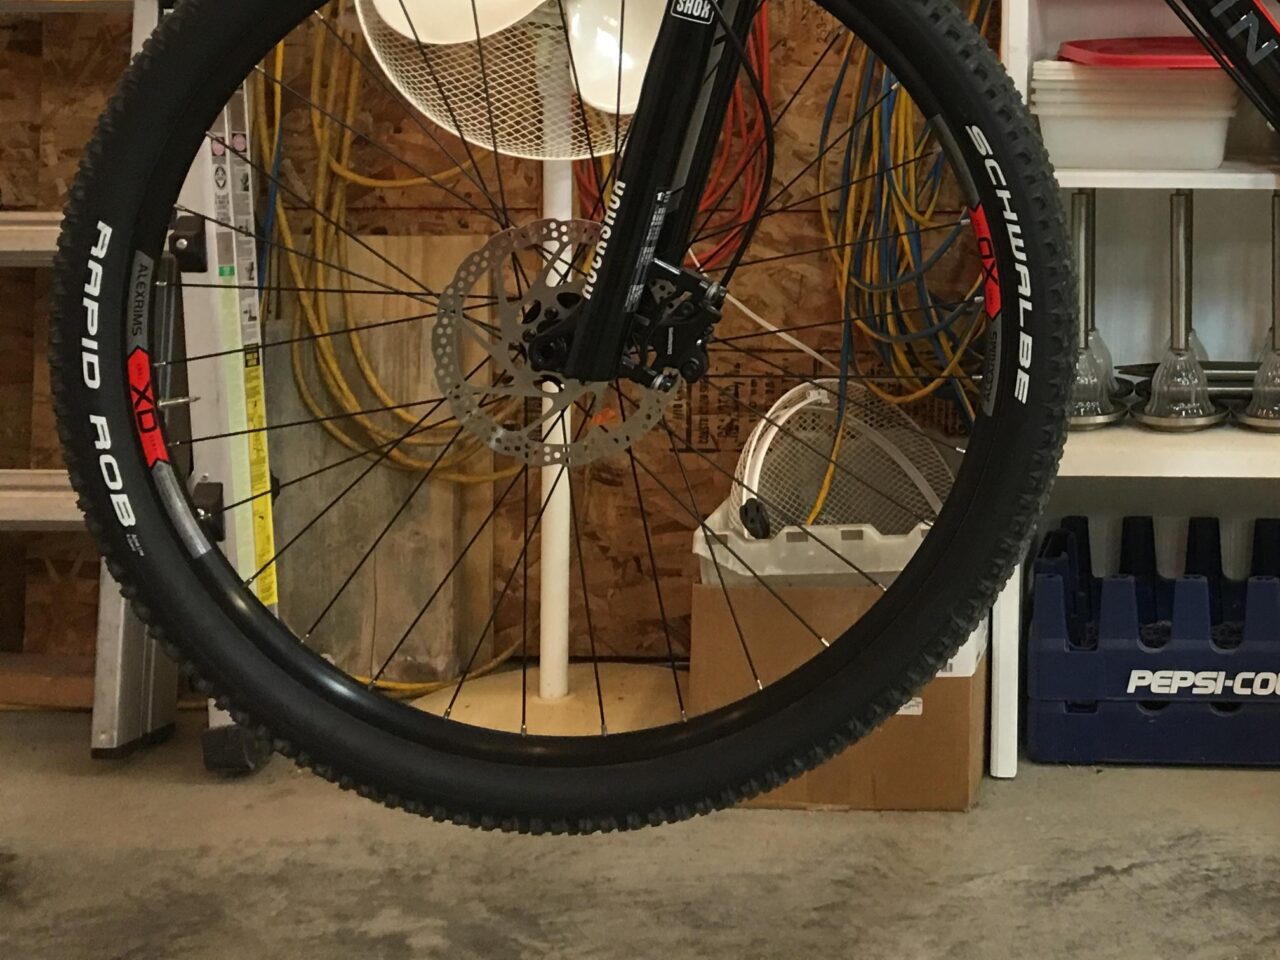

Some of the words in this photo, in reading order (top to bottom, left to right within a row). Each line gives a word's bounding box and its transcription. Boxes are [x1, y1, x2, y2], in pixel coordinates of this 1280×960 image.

[81, 220, 113, 390] RAPID
[131, 263, 149, 338] ALEXRIMS
[965, 124, 1033, 405] SCHWALBE
[89, 414, 137, 527] ROB
